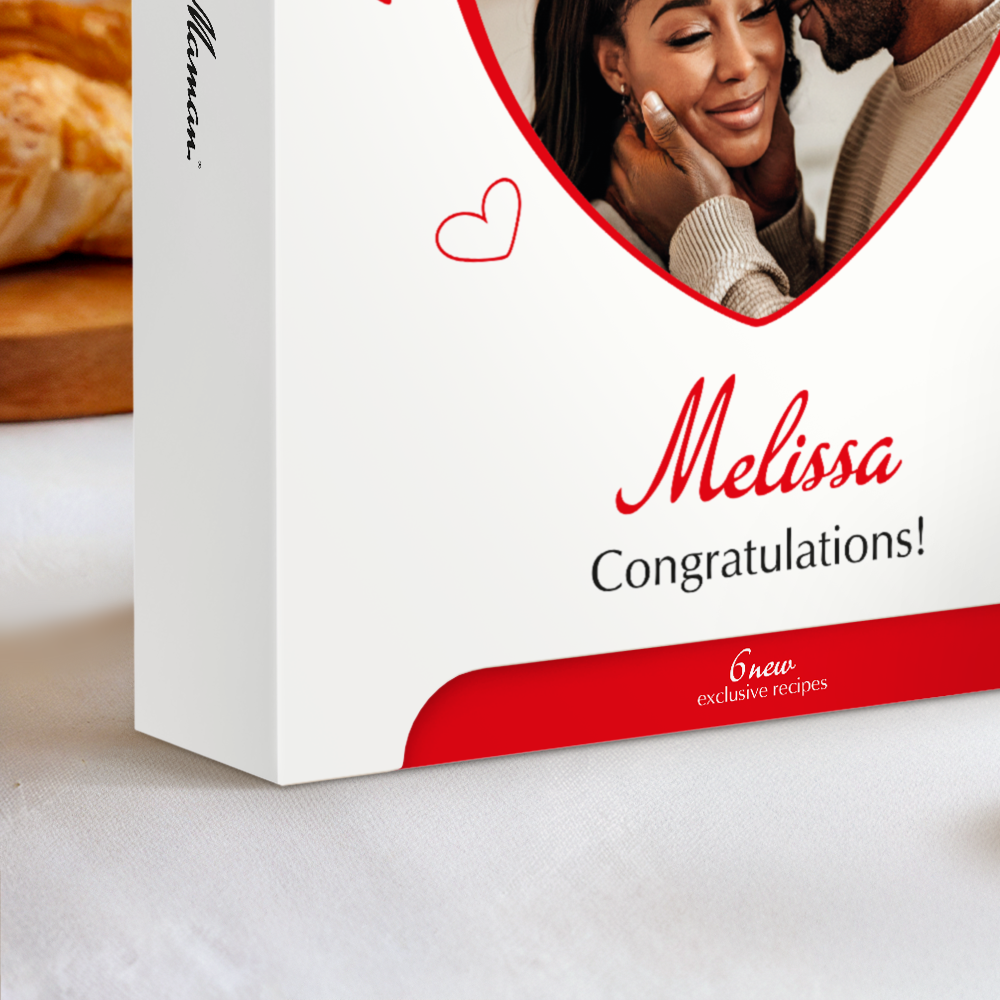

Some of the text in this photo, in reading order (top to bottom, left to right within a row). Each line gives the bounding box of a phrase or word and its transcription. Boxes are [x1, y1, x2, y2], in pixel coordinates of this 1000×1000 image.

[615, 373, 903, 515] Melissa
[591, 515, 925, 594] Congratulations!
[697, 677, 828, 707] exclusive recipes
